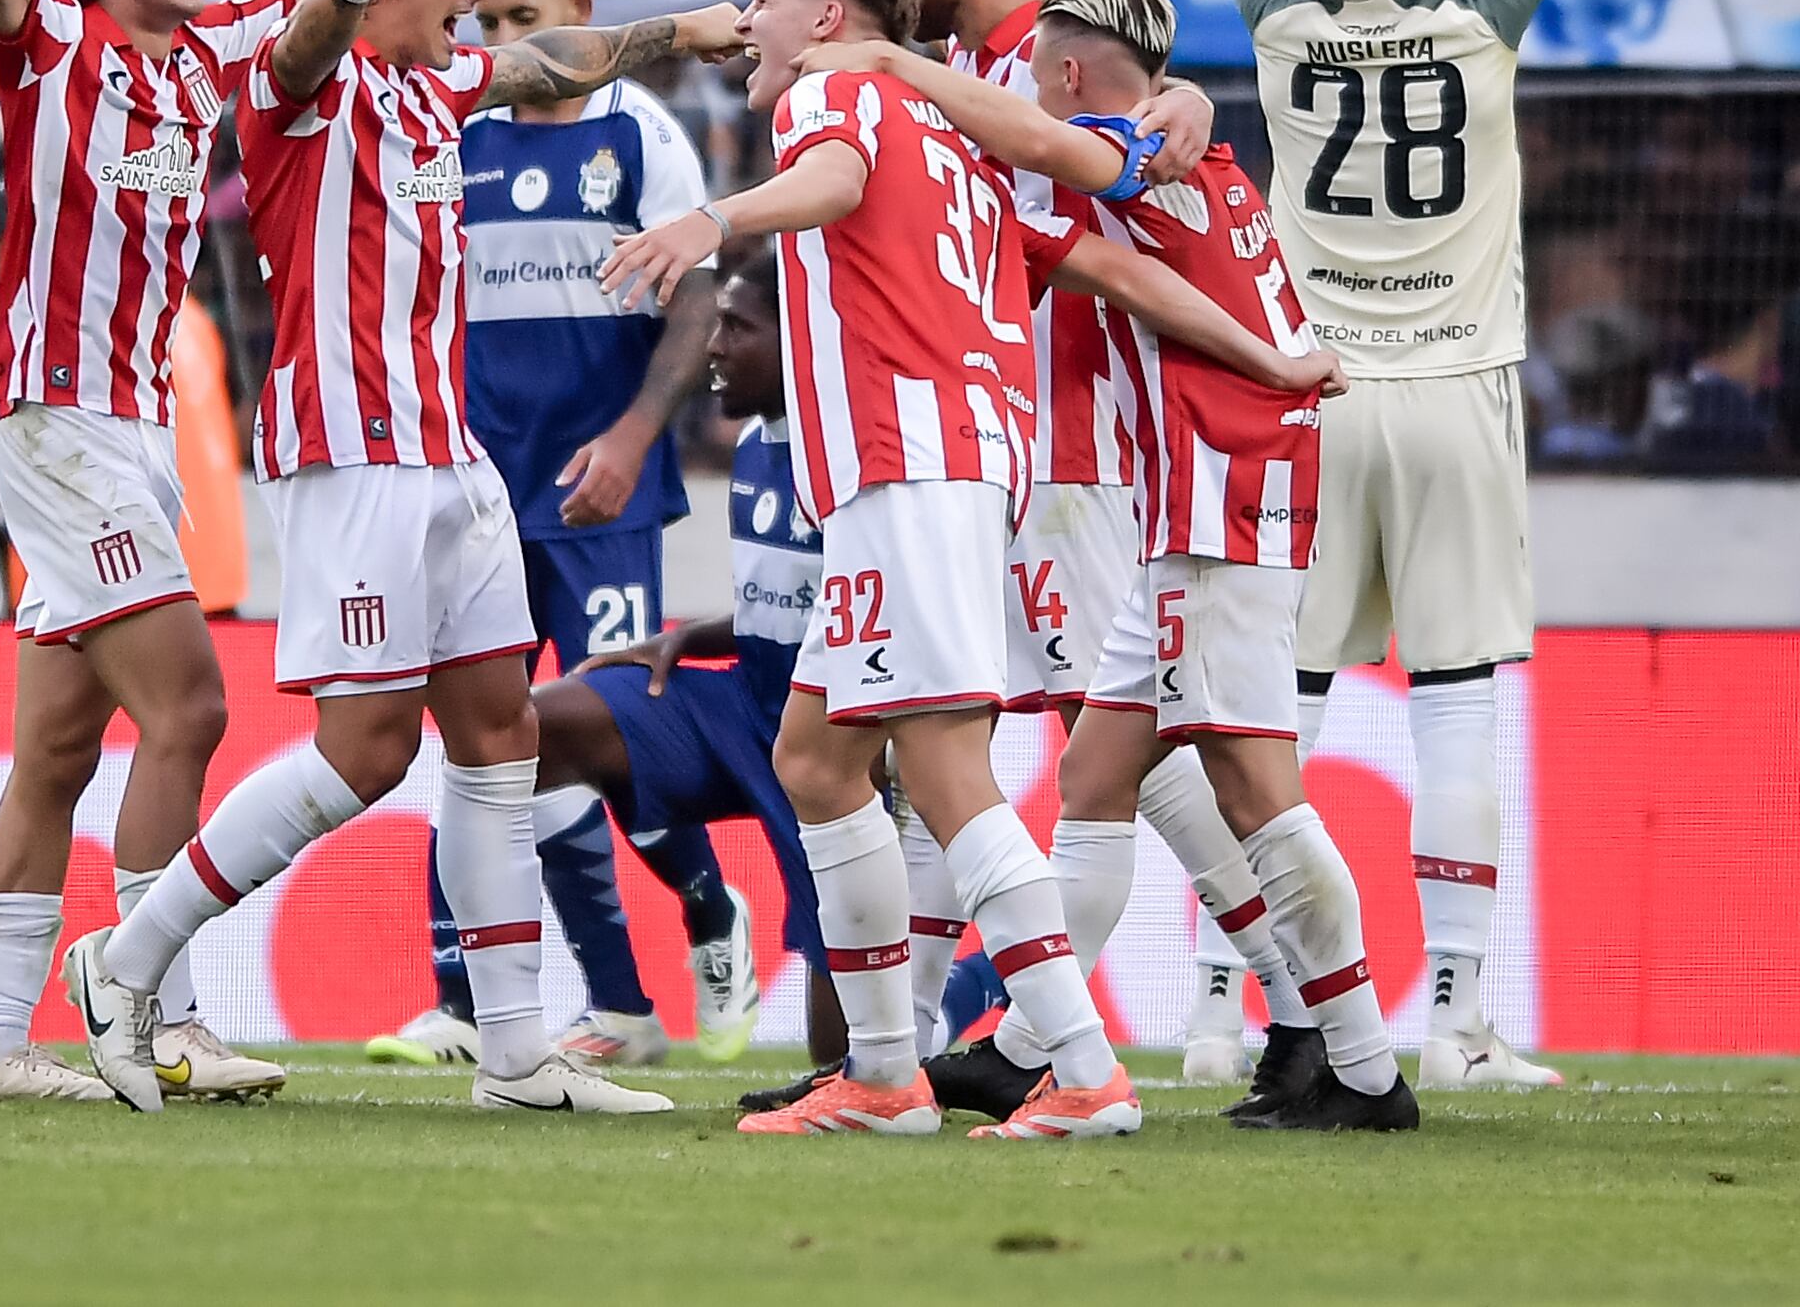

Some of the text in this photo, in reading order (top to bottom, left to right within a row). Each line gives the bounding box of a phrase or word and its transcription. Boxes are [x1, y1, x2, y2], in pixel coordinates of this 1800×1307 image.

[1304, 36, 1435, 64] MUSLERA
[1291, 60, 1468, 220] 28
[920, 134, 1028, 345] 32
[1326, 268, 1455, 293] Mejor Crédito
[1371, 329, 1406, 344] DEL
[1413, 323, 1479, 344] MUNDO
[585, 585, 647, 654] 21
[824, 568, 893, 649] 32
[1156, 589, 1186, 662] 5
